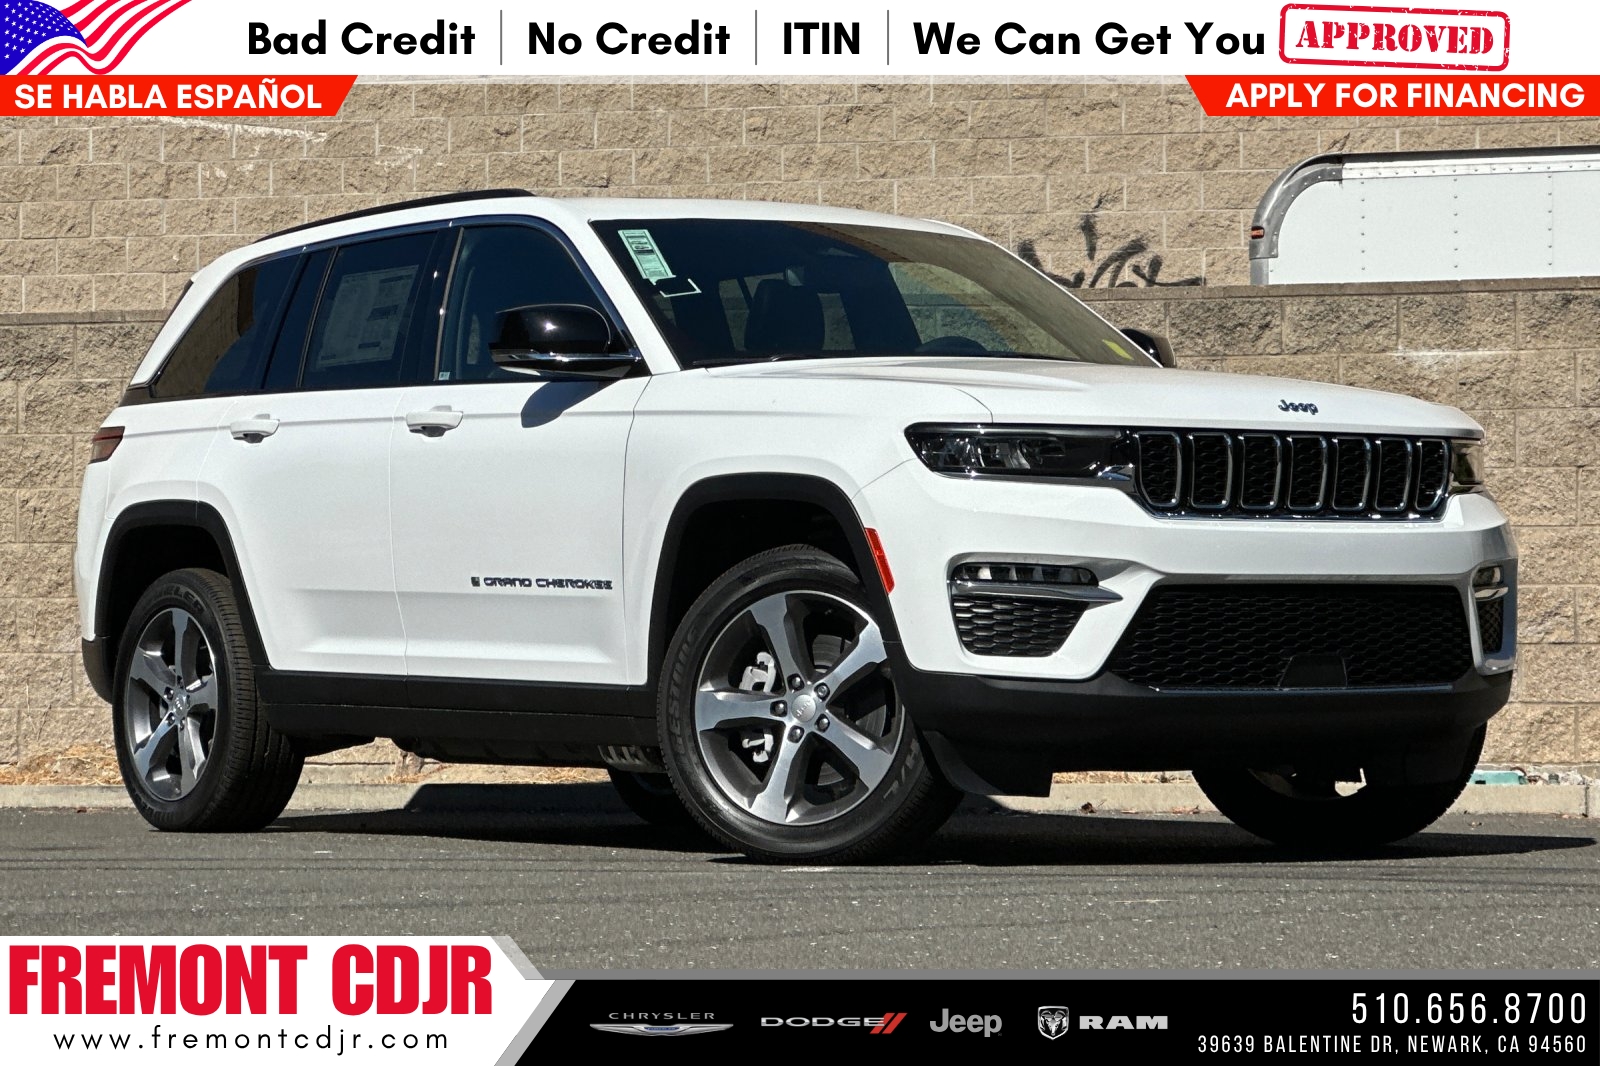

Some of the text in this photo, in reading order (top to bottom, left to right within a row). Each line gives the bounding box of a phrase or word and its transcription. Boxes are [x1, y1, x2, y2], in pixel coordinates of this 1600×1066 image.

[1278, 399, 1319, 416] Jeep
[484, 577, 613, 590] GRAND CHEROKEE
